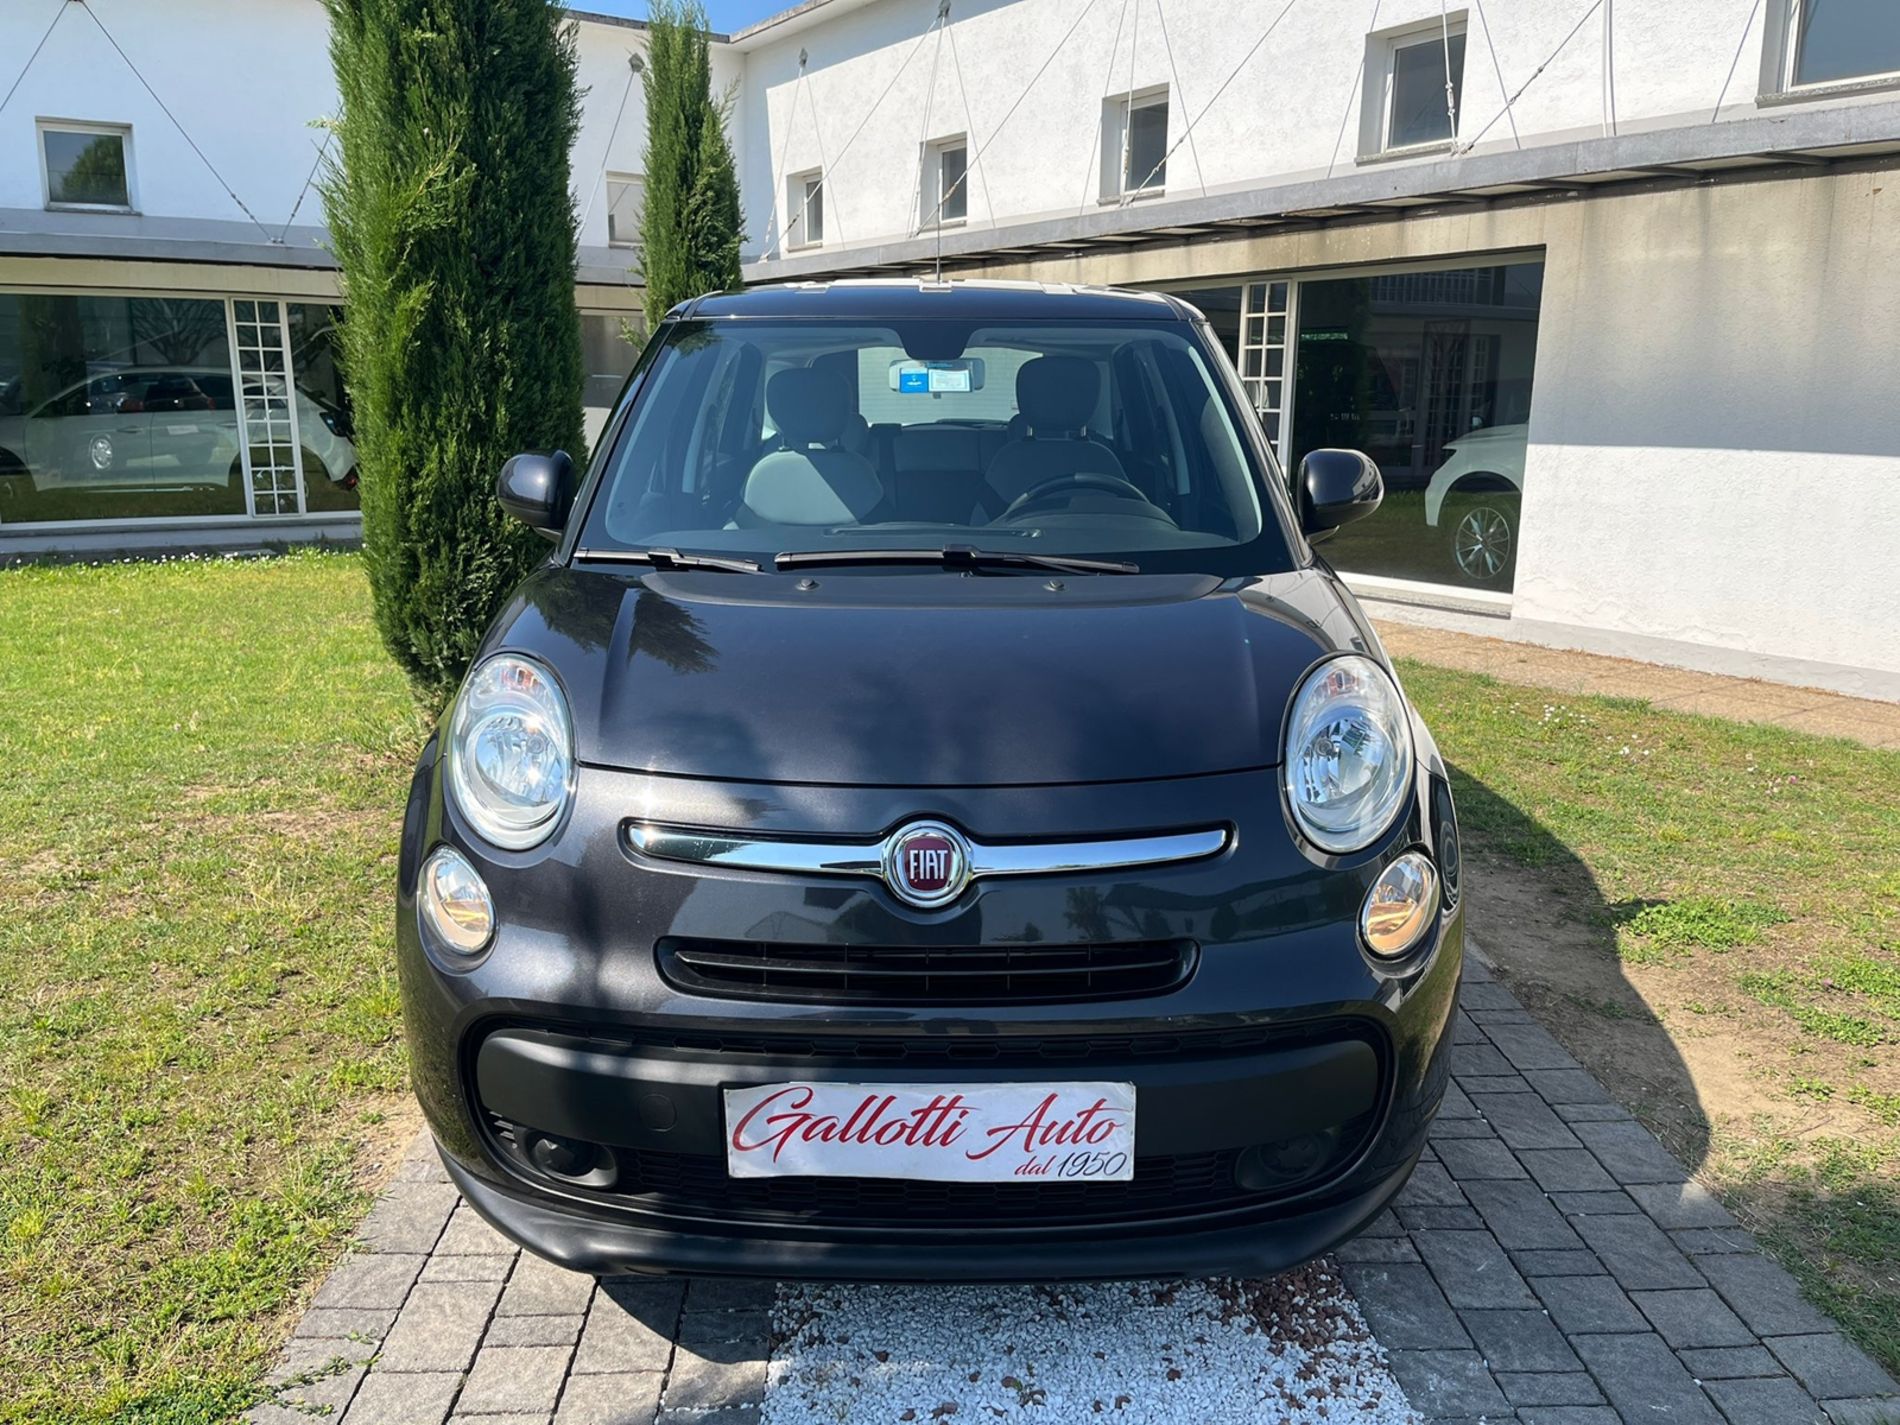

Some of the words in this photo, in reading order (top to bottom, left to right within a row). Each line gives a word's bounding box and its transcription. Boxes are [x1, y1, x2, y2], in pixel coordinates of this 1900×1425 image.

[909, 849, 948, 880] FIAT
[732, 1086, 981, 1163] Gallotti
[966, 1092, 1134, 1160] Auto
[1014, 1154, 1055, 1176] dal
[1057, 1151, 1128, 1178] 1950
